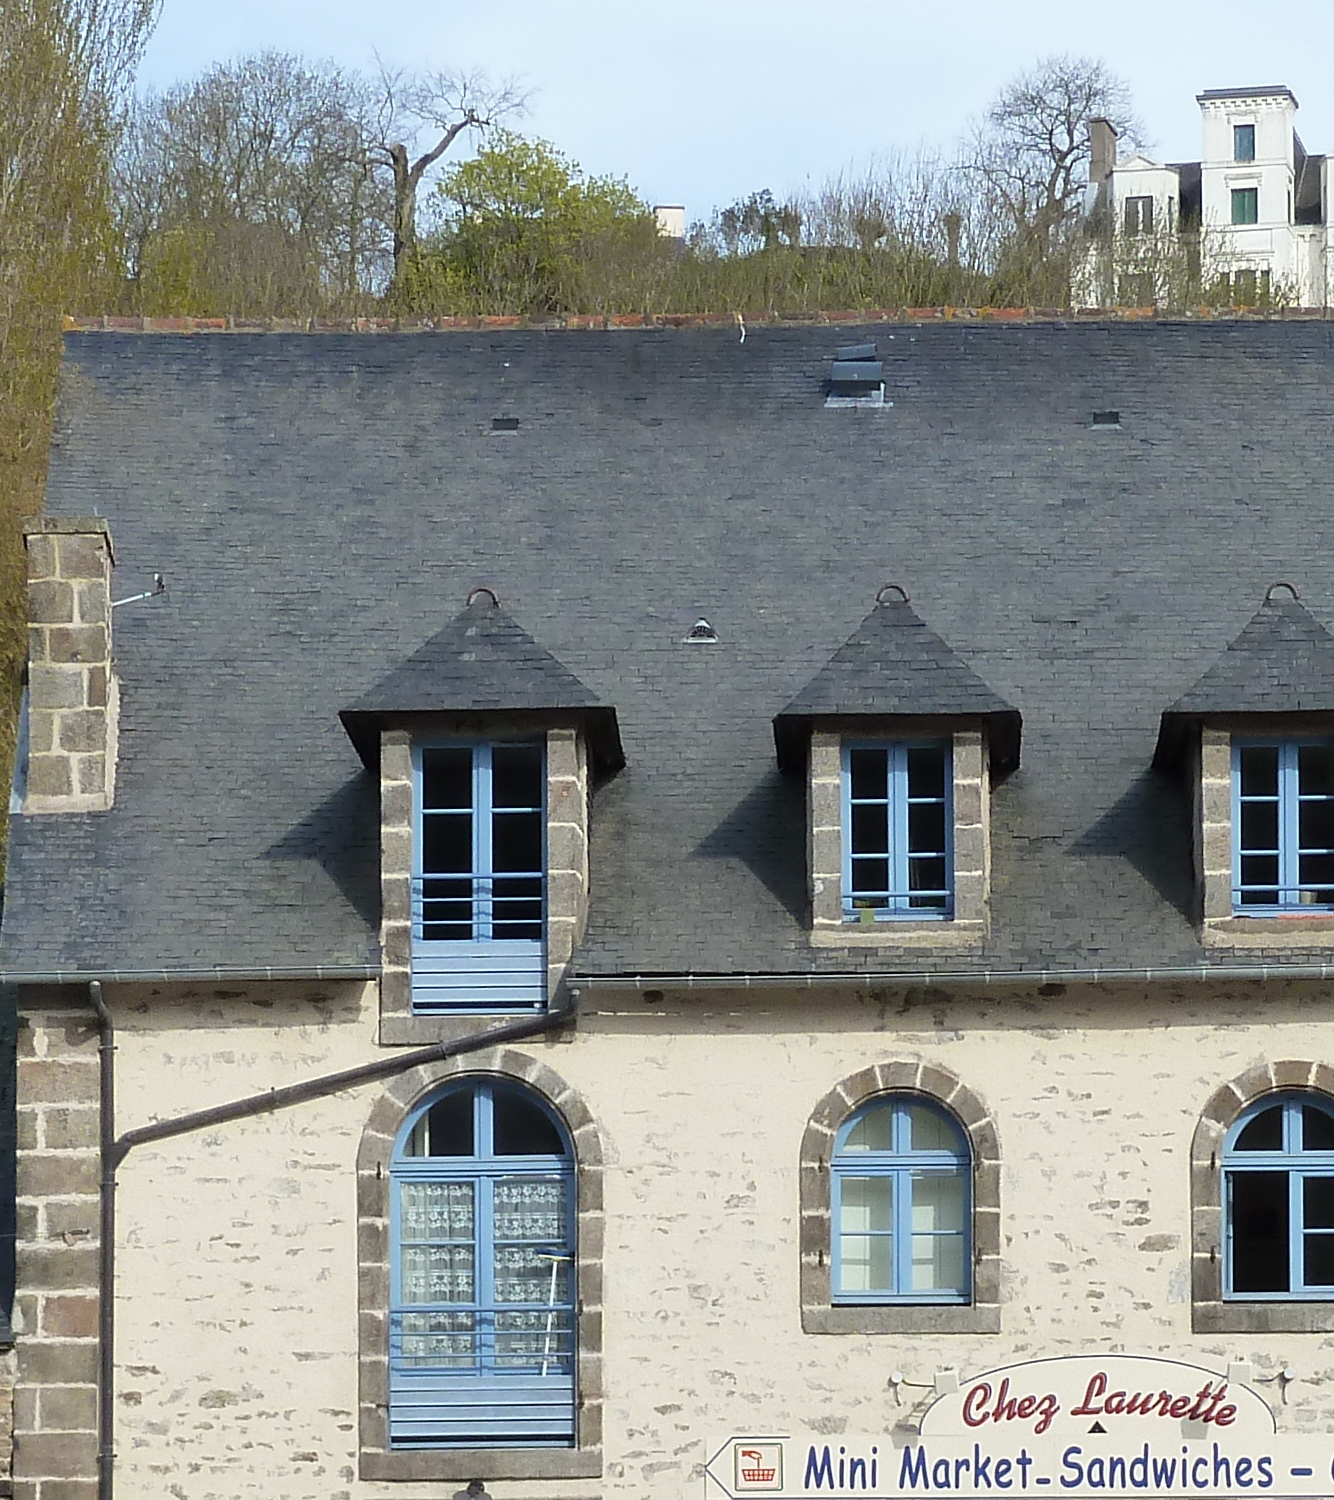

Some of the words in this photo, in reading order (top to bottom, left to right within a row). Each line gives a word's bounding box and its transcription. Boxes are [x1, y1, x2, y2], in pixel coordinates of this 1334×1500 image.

[962, 1377, 1060, 1434] Chez
[1071, 1372, 1237, 1427] Laurette
[804, 1445, 878, 1490] Mini
